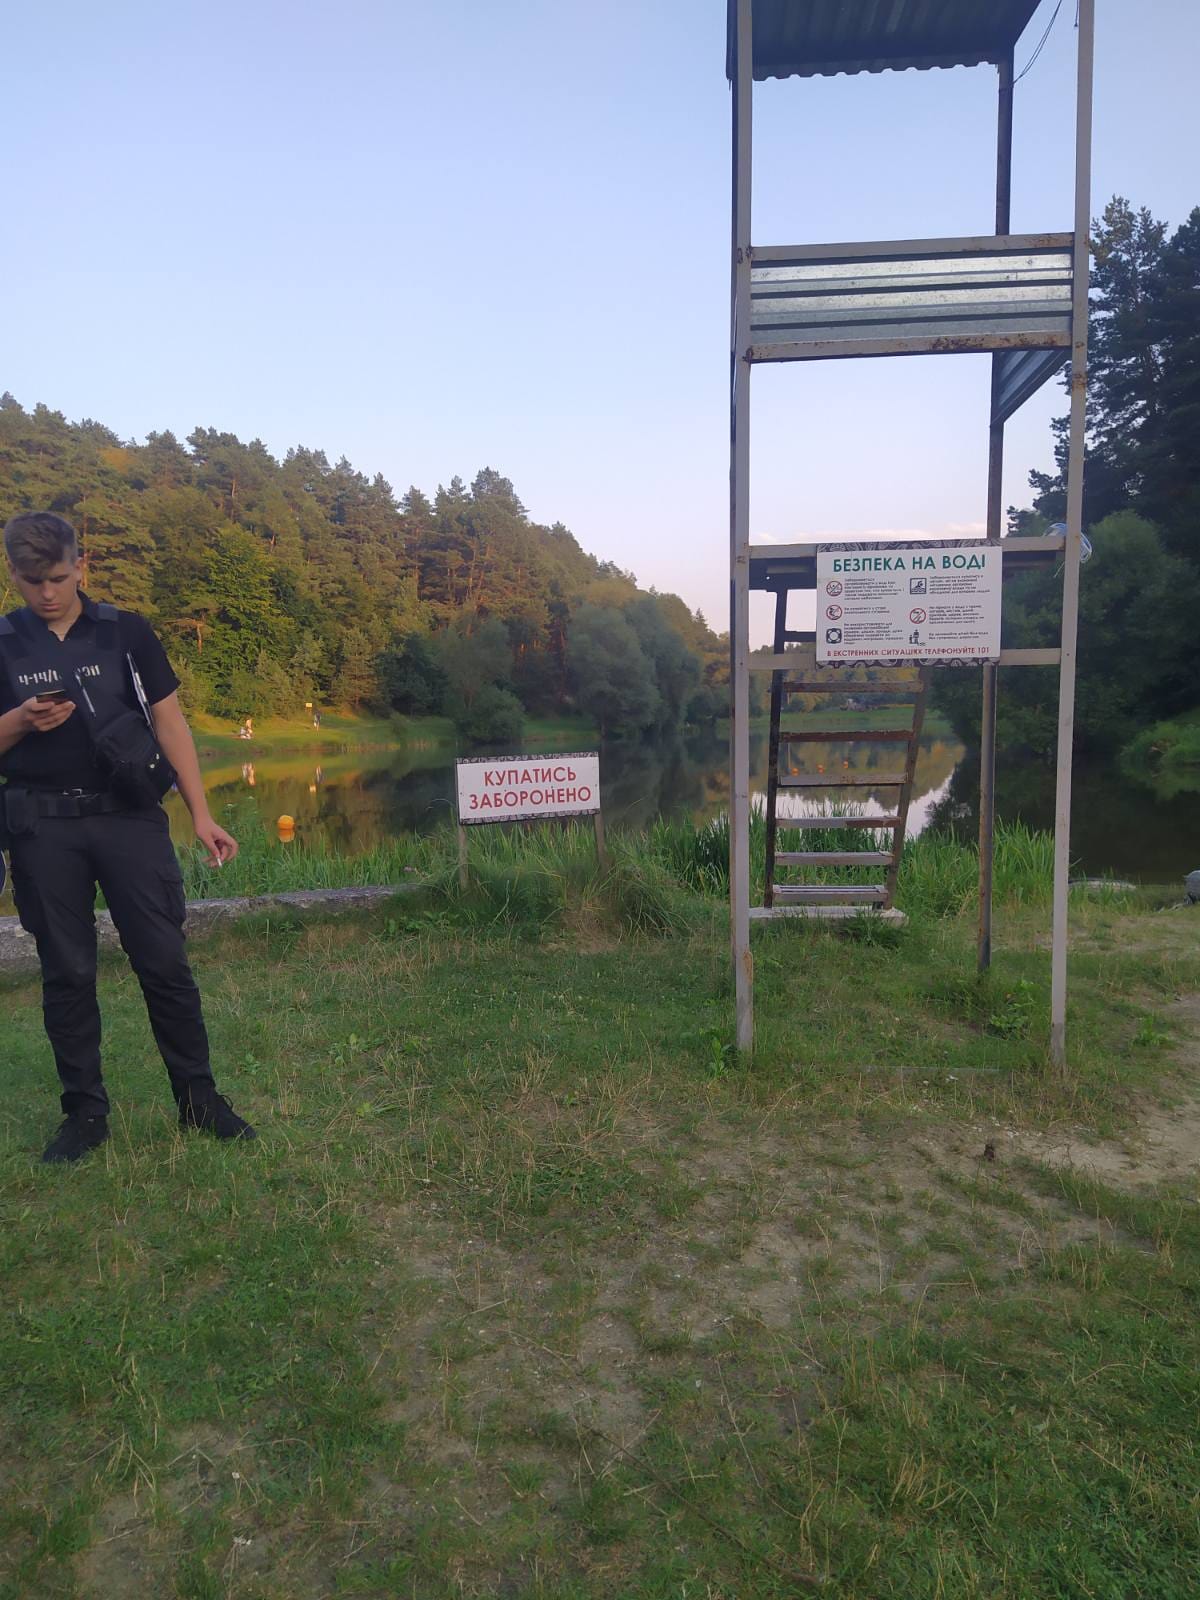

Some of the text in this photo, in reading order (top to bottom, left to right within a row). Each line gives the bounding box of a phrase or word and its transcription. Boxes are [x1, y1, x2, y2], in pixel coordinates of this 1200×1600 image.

[833, 554, 985, 572] БЕЗПЕКА НА ВОДІ
[833, 649, 879, 657] ЕКСТРЕННИХ
[924, 646, 975, 655] ТЕЛЕФОНУЙТЕ
[978, 646, 990, 654] 101
[484, 767, 577, 787] КУПАТИСЬ
[469, 786, 591, 810] ЗАБОРОНЕНО
